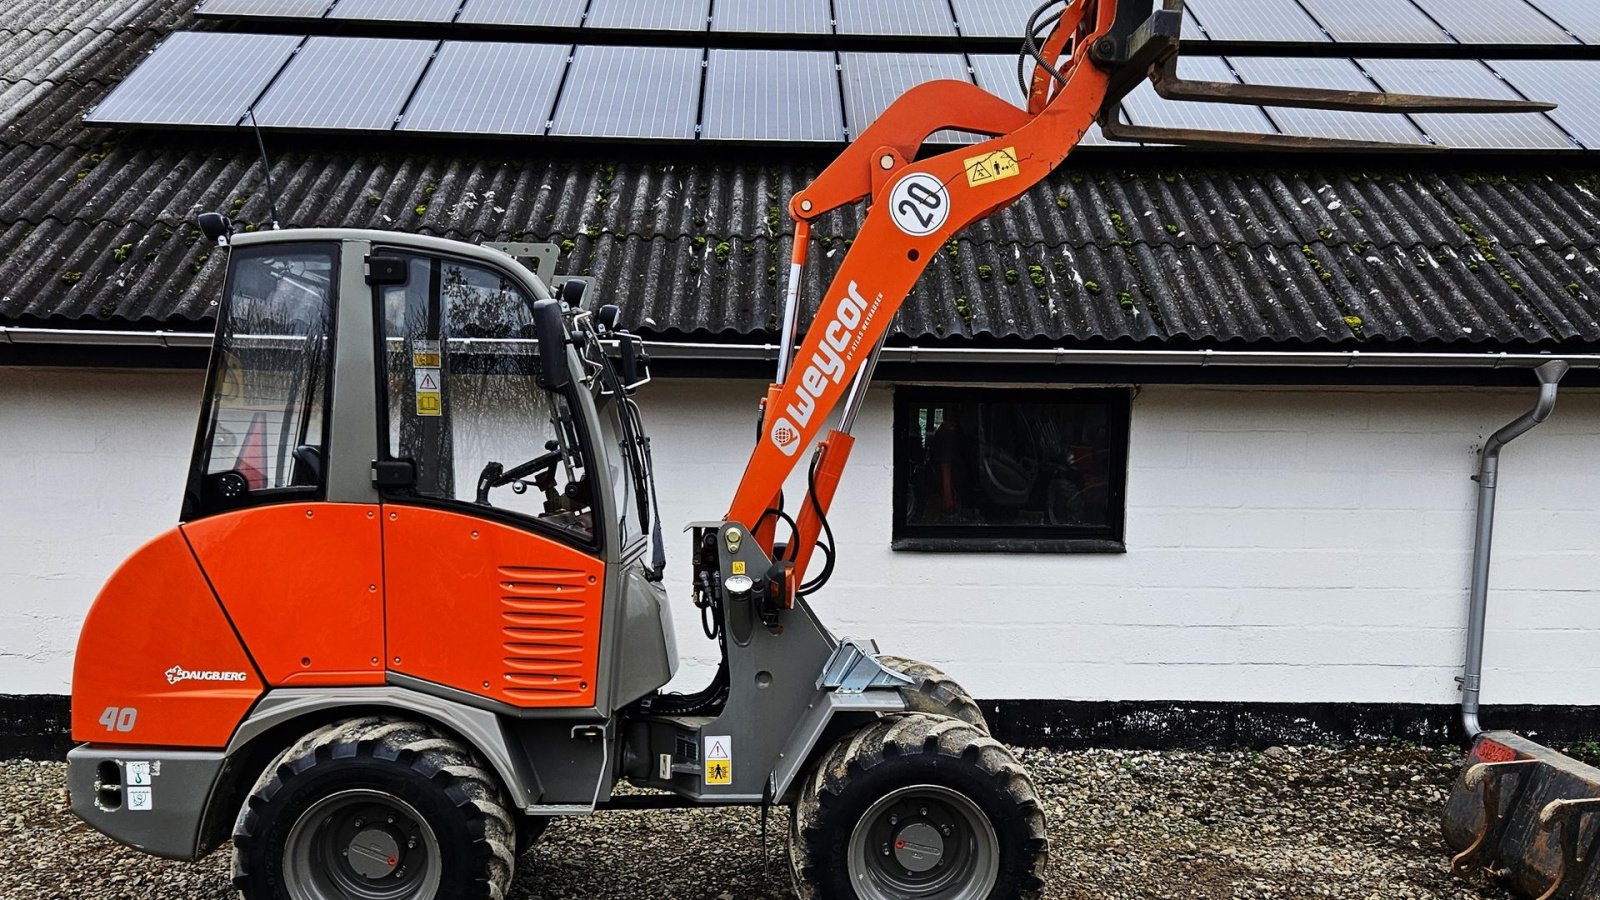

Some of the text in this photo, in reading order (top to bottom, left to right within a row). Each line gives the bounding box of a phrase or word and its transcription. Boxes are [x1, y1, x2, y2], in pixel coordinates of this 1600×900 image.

[898, 182, 942, 229] 20
[846, 291, 884, 361] BY ATLAS WEYHAUSEN
[786, 279, 869, 429] weycor
[181, 670, 247, 682] DAUGBJERG
[98, 706, 138, 733] 40
